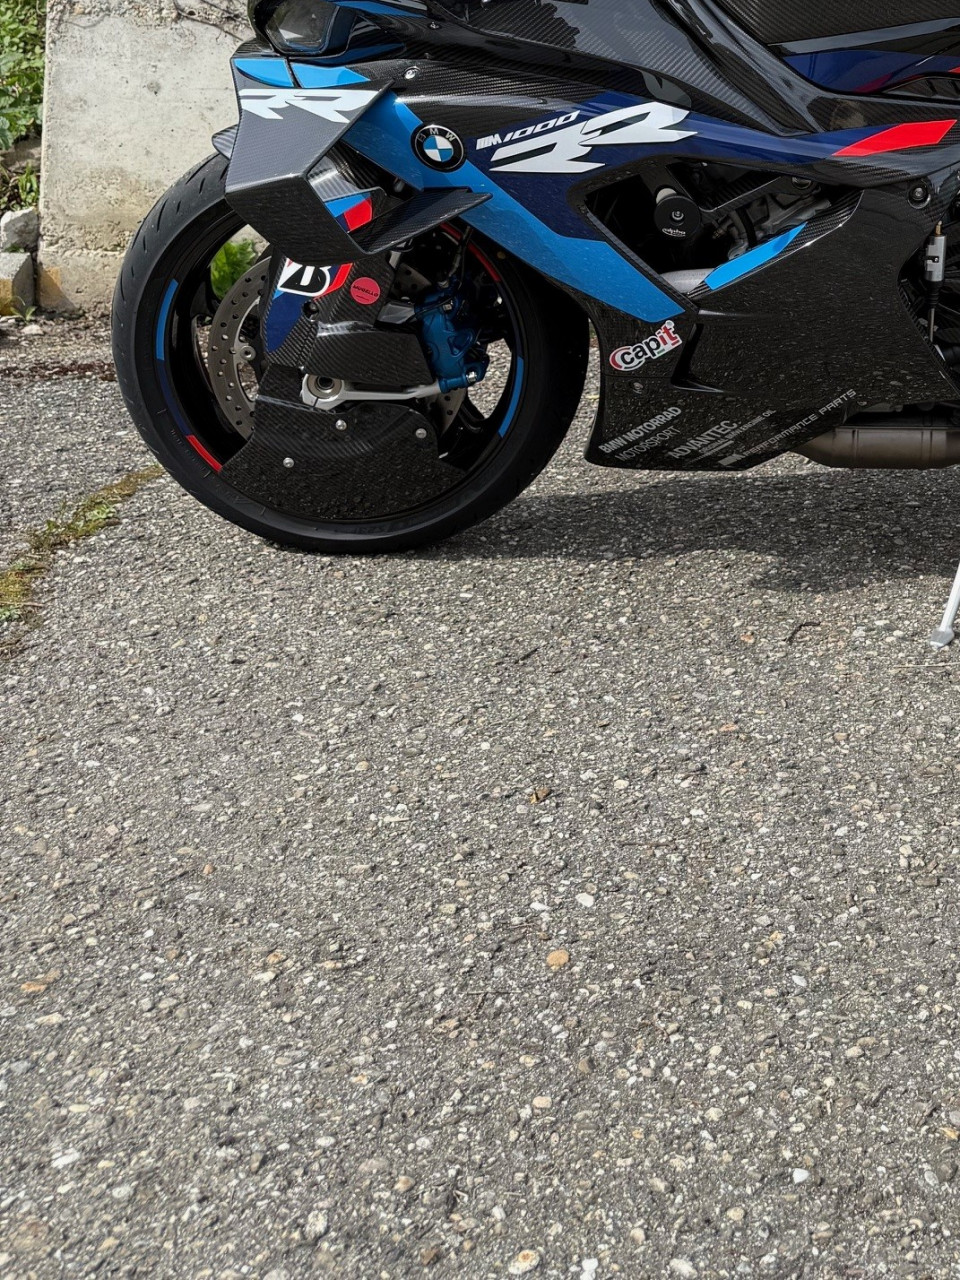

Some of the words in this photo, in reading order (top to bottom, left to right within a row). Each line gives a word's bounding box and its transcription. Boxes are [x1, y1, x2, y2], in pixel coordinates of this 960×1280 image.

[416, 126, 456, 142] BMW
[488, 101, 699, 173] RR
[620, 324, 679, 367] capit
[598, 436, 628, 454] BMW
[622, 406, 682, 442] MOTORRAD
[615, 425, 682, 462] MOTORSPORT
[667, 420, 738, 460] ADVANTEC
[743, 413, 818, 457] PERFORMANCE
[818, 388, 857, 416] PARTS
